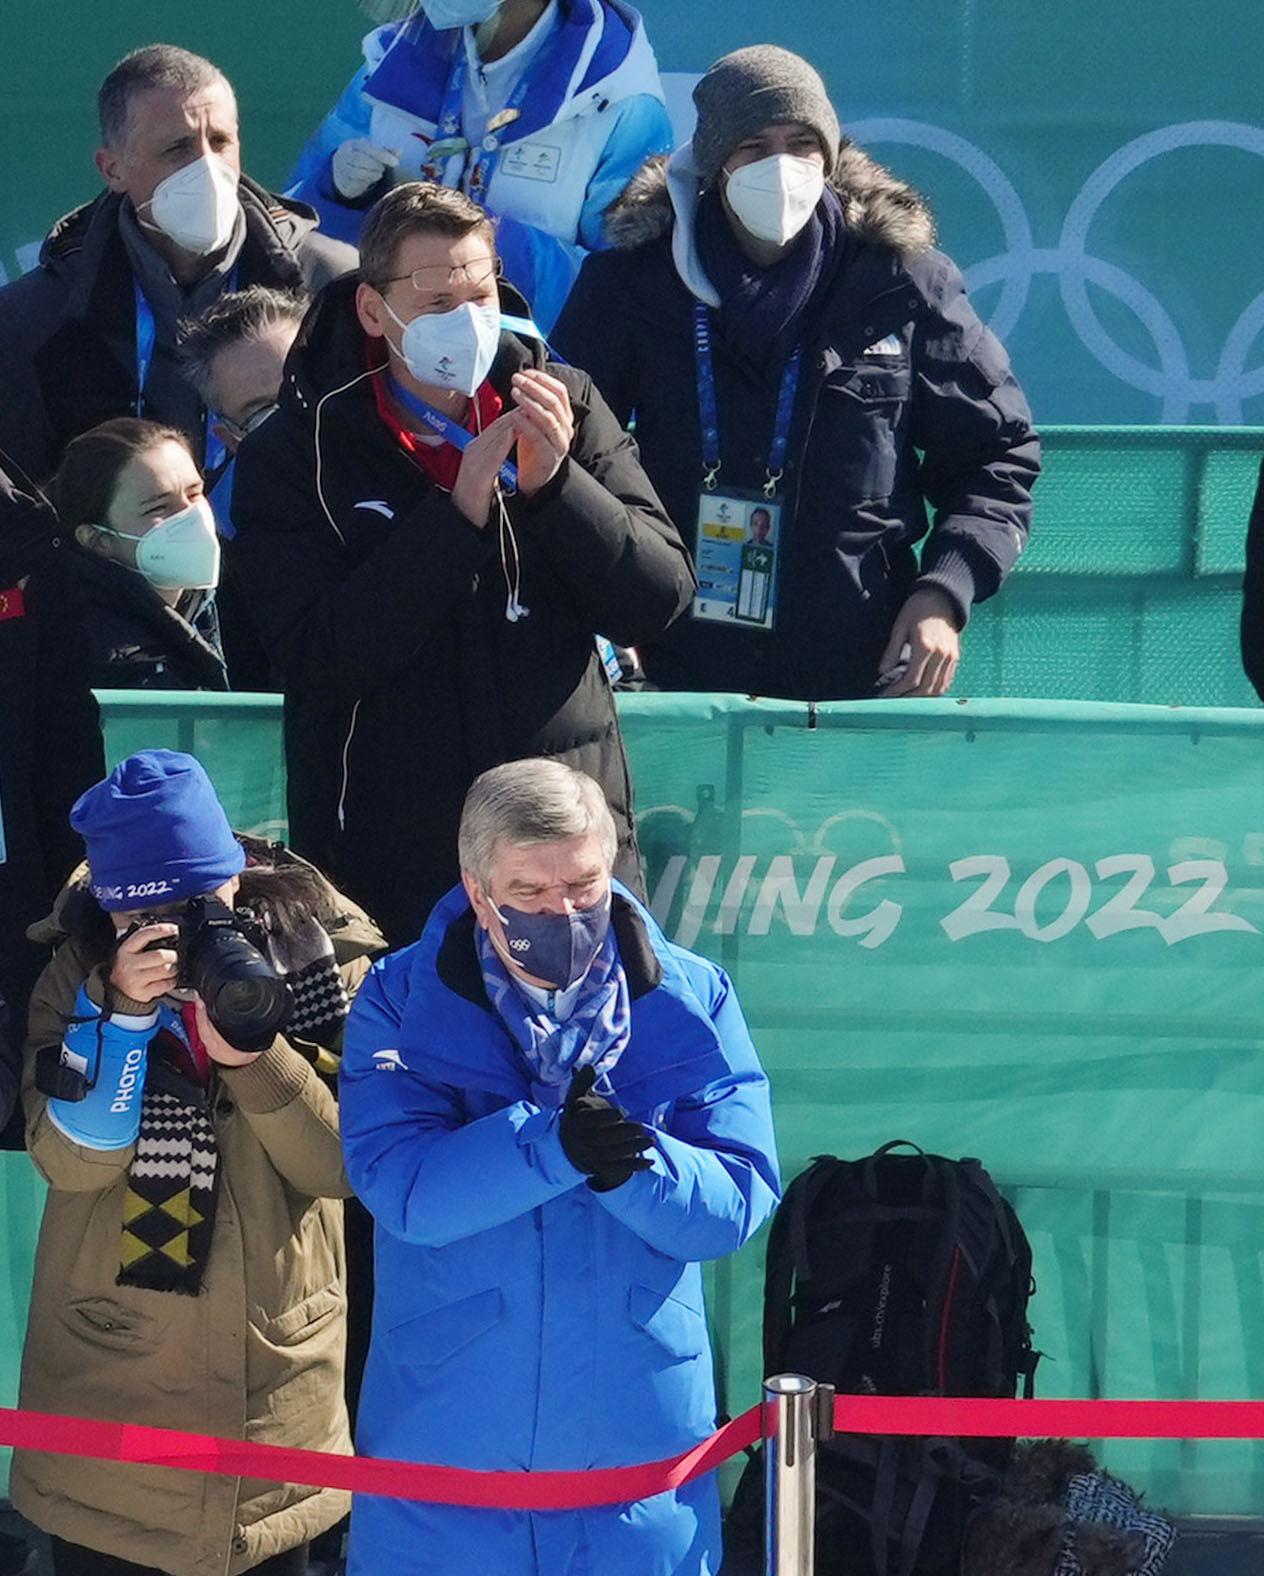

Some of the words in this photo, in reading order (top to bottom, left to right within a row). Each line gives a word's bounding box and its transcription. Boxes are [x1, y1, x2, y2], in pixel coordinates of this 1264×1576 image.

[127, 880, 173, 898] 2022
[648, 854, 906, 949] IJING
[939, 853, 1262, 946] 2022
[109, 1048, 144, 1114] PHOTO
